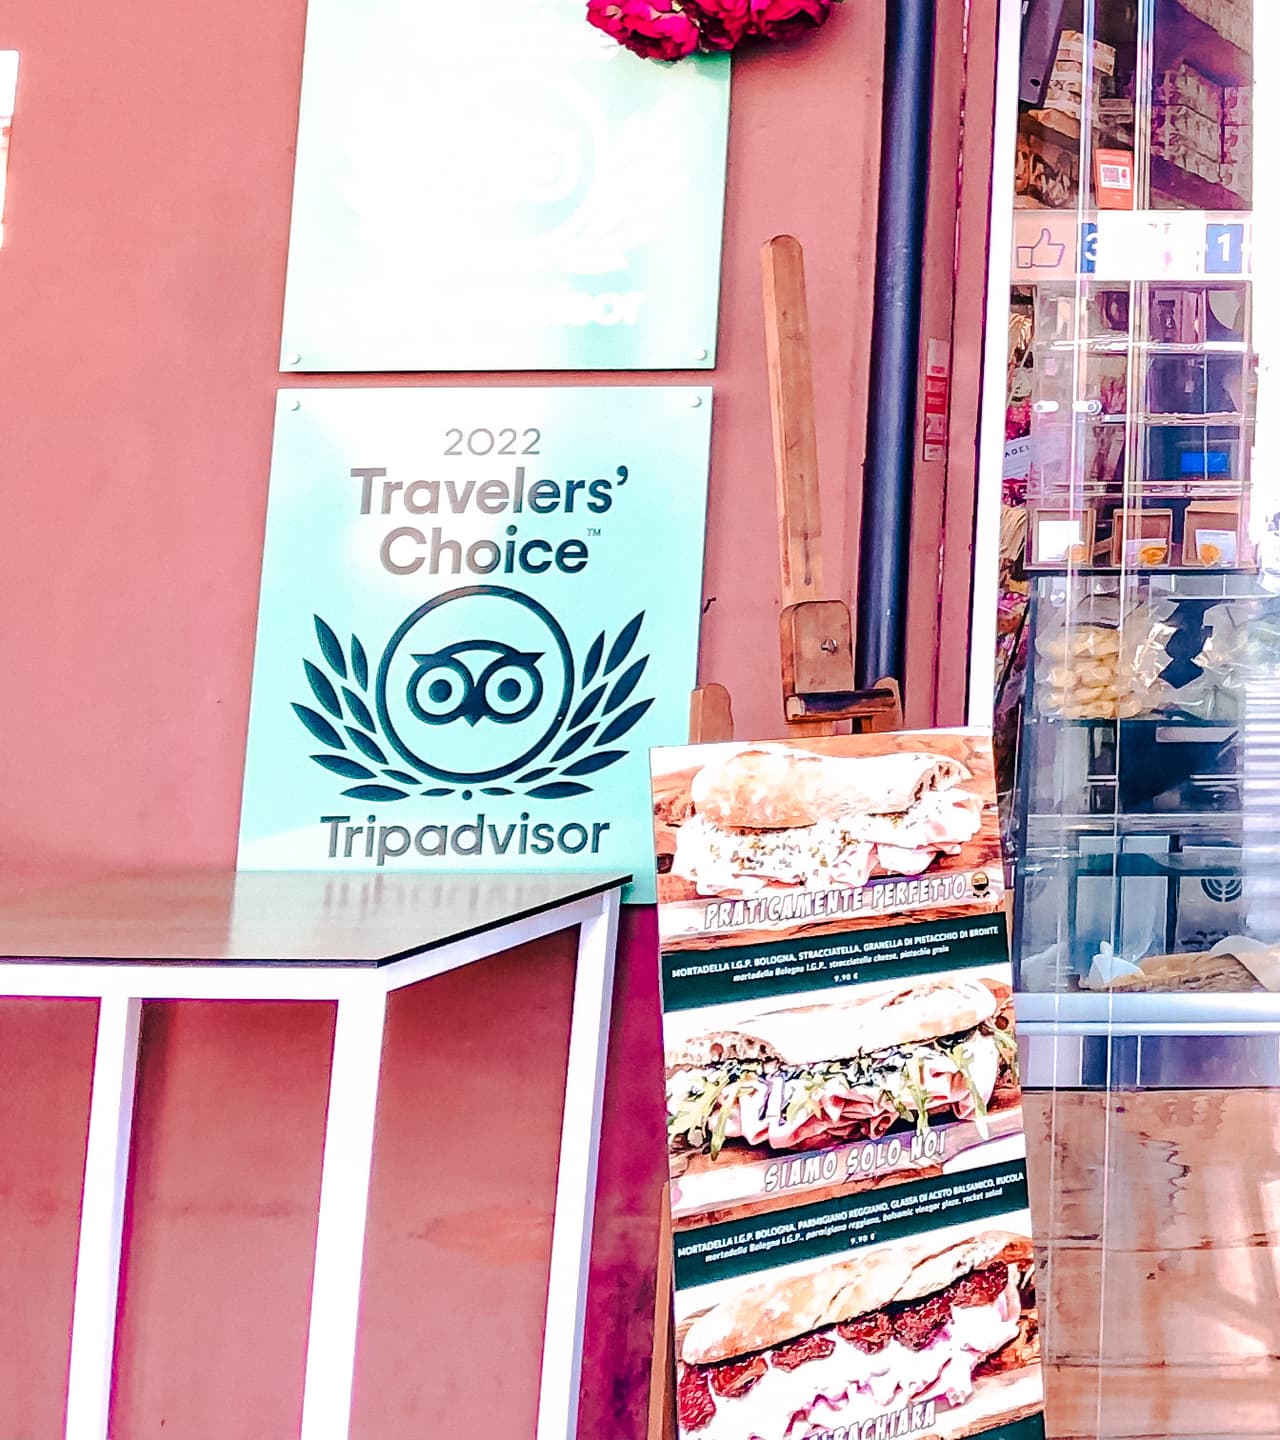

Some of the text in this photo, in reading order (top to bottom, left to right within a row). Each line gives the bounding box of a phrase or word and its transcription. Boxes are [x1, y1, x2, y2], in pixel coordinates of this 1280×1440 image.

[444, 427, 542, 456] 2022
[320, 812, 610, 866] Tripadvisor
[704, 886, 864, 930] PRATICAMENTE
[870, 875, 967, 909] PERFETTO
[671, 962, 730, 979] MORTADELLA
[863, 939, 903, 952] GRANELLA
[904, 937, 913, 947] DI
[914, 931, 958, 946] PISTACCHIO
[959, 929, 968, 939] DI
[969, 926, 999, 938] BRONTE
[764, 1129, 947, 1192] SIAMO SOLO NOI
[678, 1237, 733, 1258] MORTADELLA
[798, 1211, 847, 1229] PARMIGIANO
[891, 1195, 918, 1210] GLASSA
[919, 1193, 927, 1202] DI
[928, 1187, 952, 1202] ACETO
[996, 1172, 1024, 1186] RUCOLA
